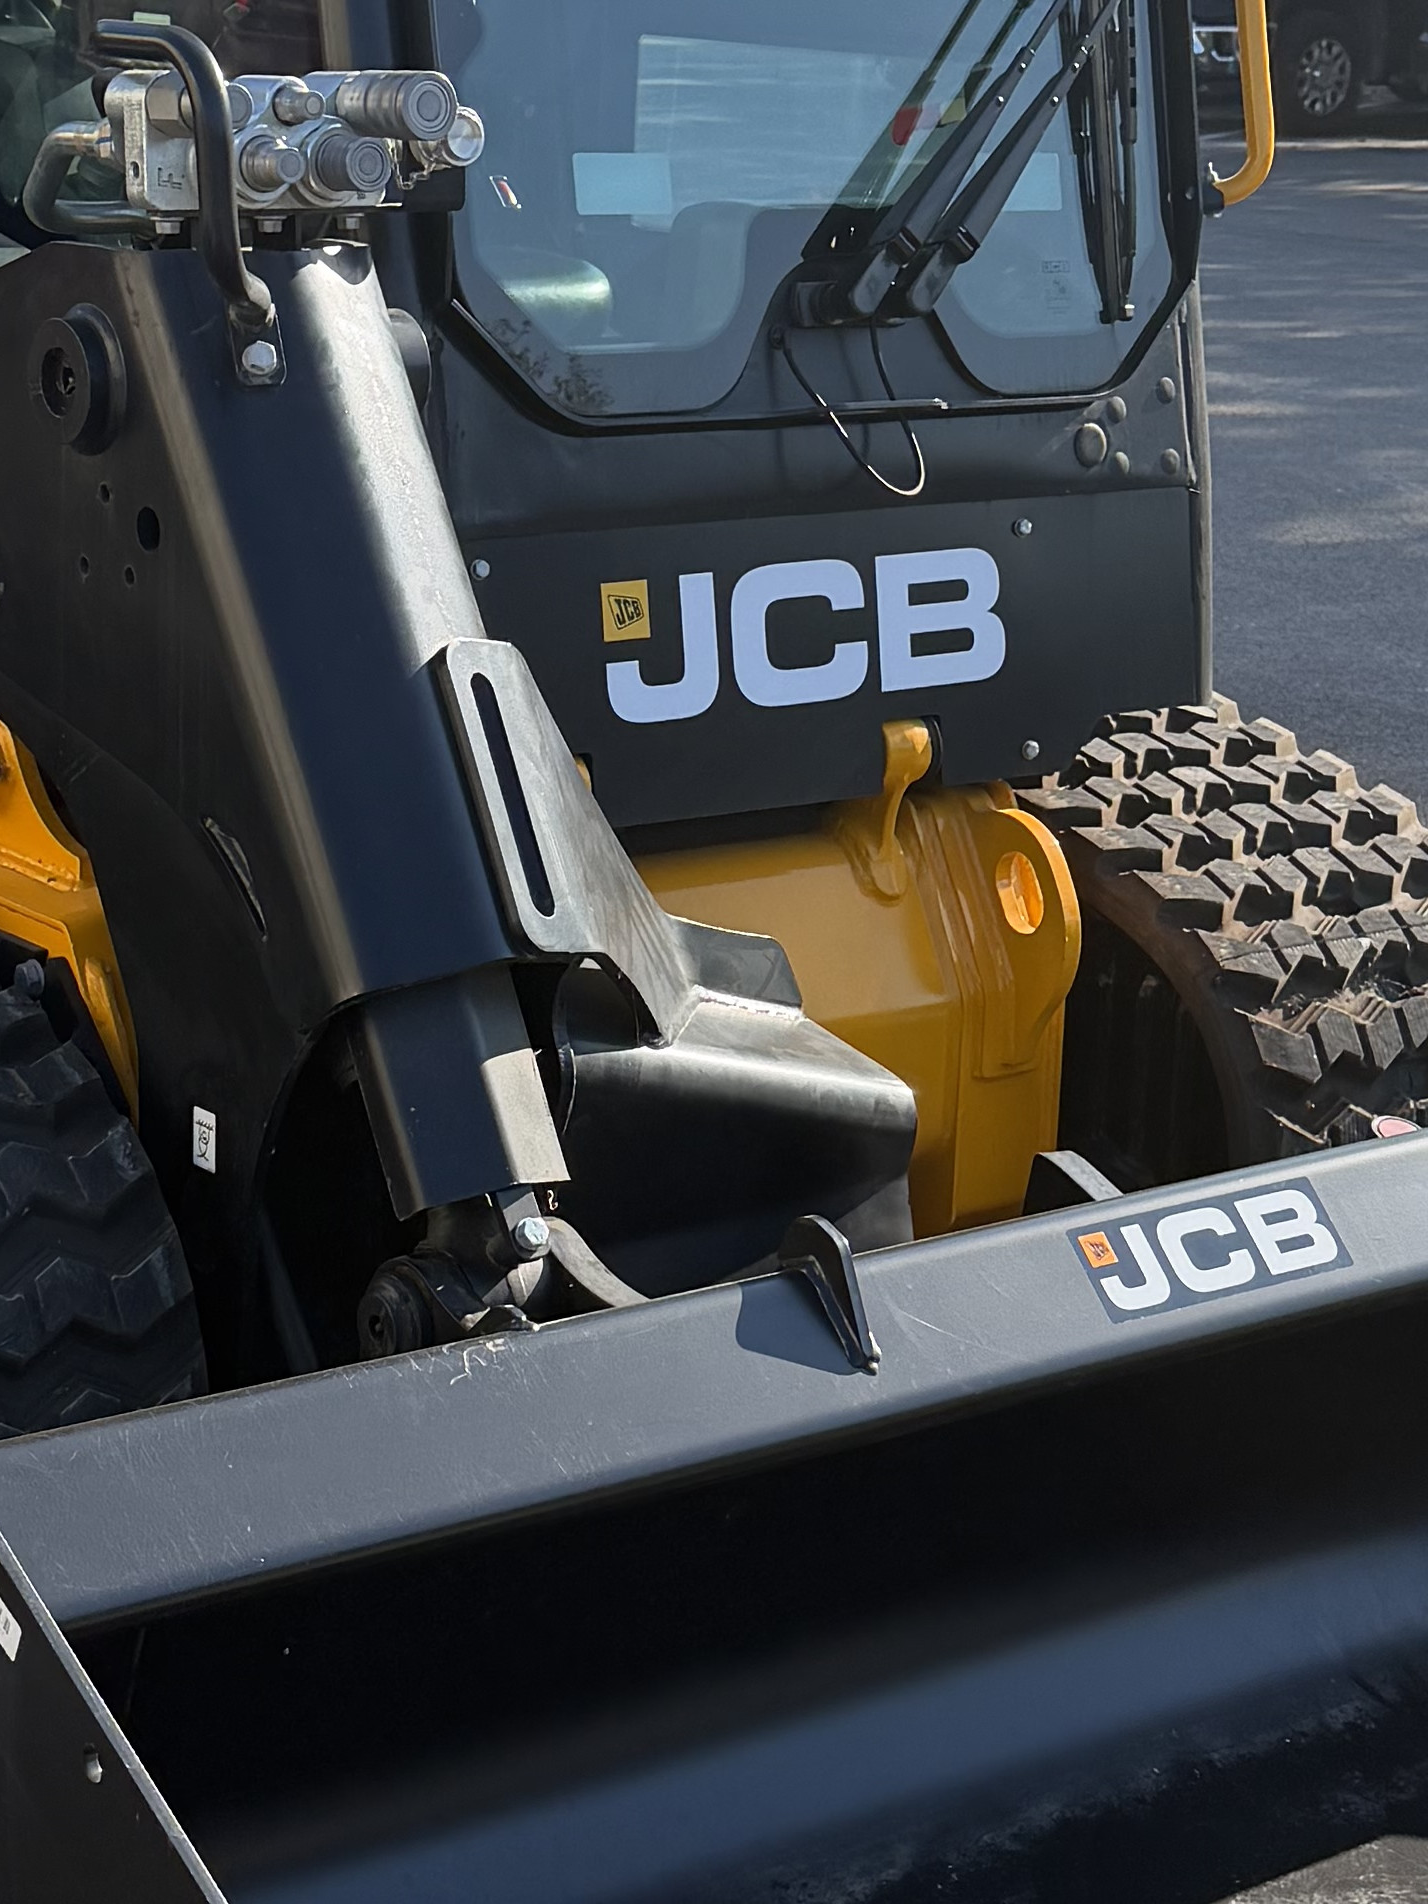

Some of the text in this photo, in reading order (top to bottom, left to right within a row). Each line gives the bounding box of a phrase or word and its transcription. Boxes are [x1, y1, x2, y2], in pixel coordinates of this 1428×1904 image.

[605, 547, 1006, 724] JCB
[614, 598, 642, 626] JCB
[1099, 1189, 1338, 1311] JCB
